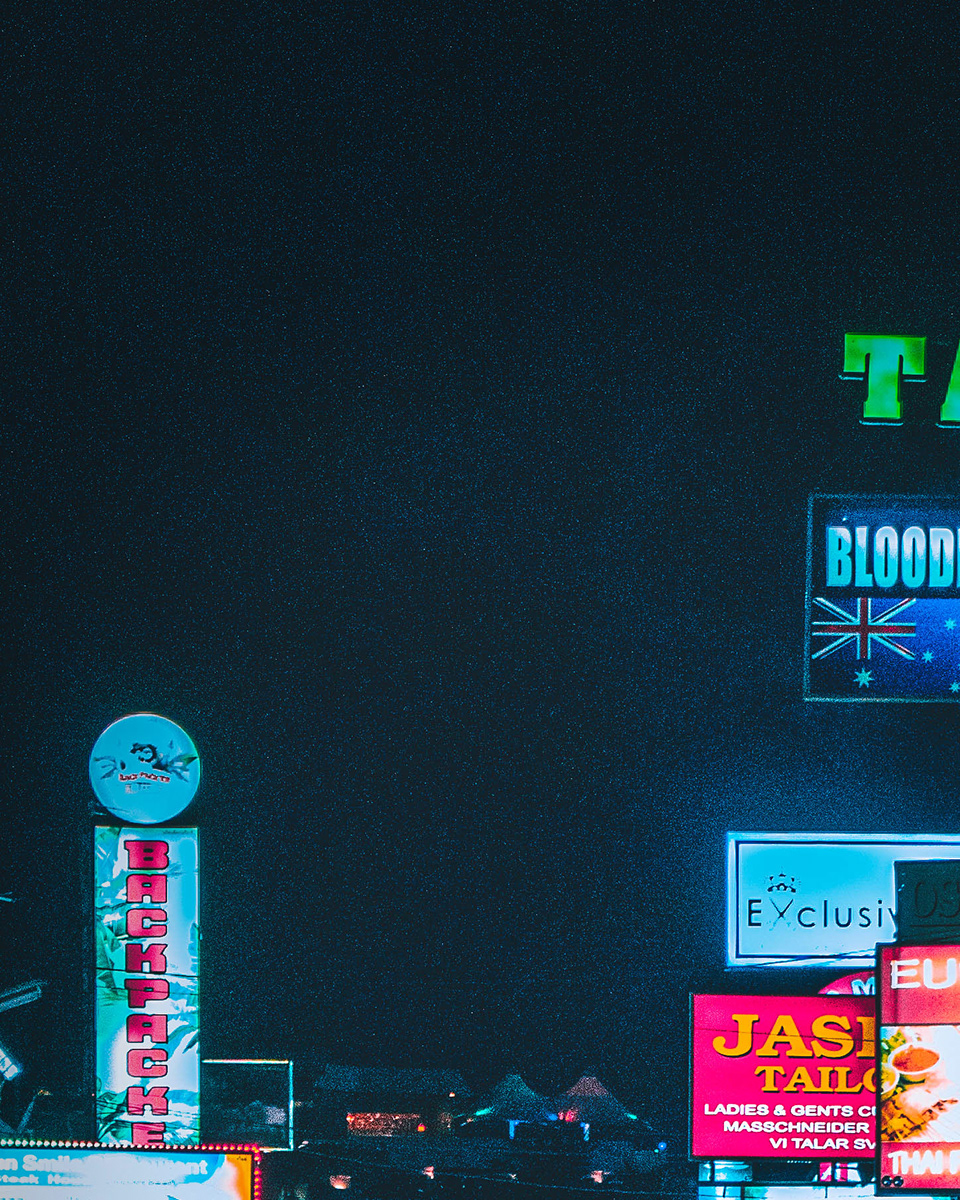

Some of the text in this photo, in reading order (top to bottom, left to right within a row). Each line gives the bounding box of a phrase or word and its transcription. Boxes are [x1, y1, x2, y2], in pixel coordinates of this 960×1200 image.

[704, 1104, 769, 1116] LADIES
[773, 1105, 786, 1116] &
[790, 1105, 854, 1117] GENTS
[723, 1121, 870, 1134] MASSCHNEIDER
[769, 1138, 787, 1149] VI
[791, 1138, 849, 1150] TALAR
[888, 1150, 943, 1175] THAI
